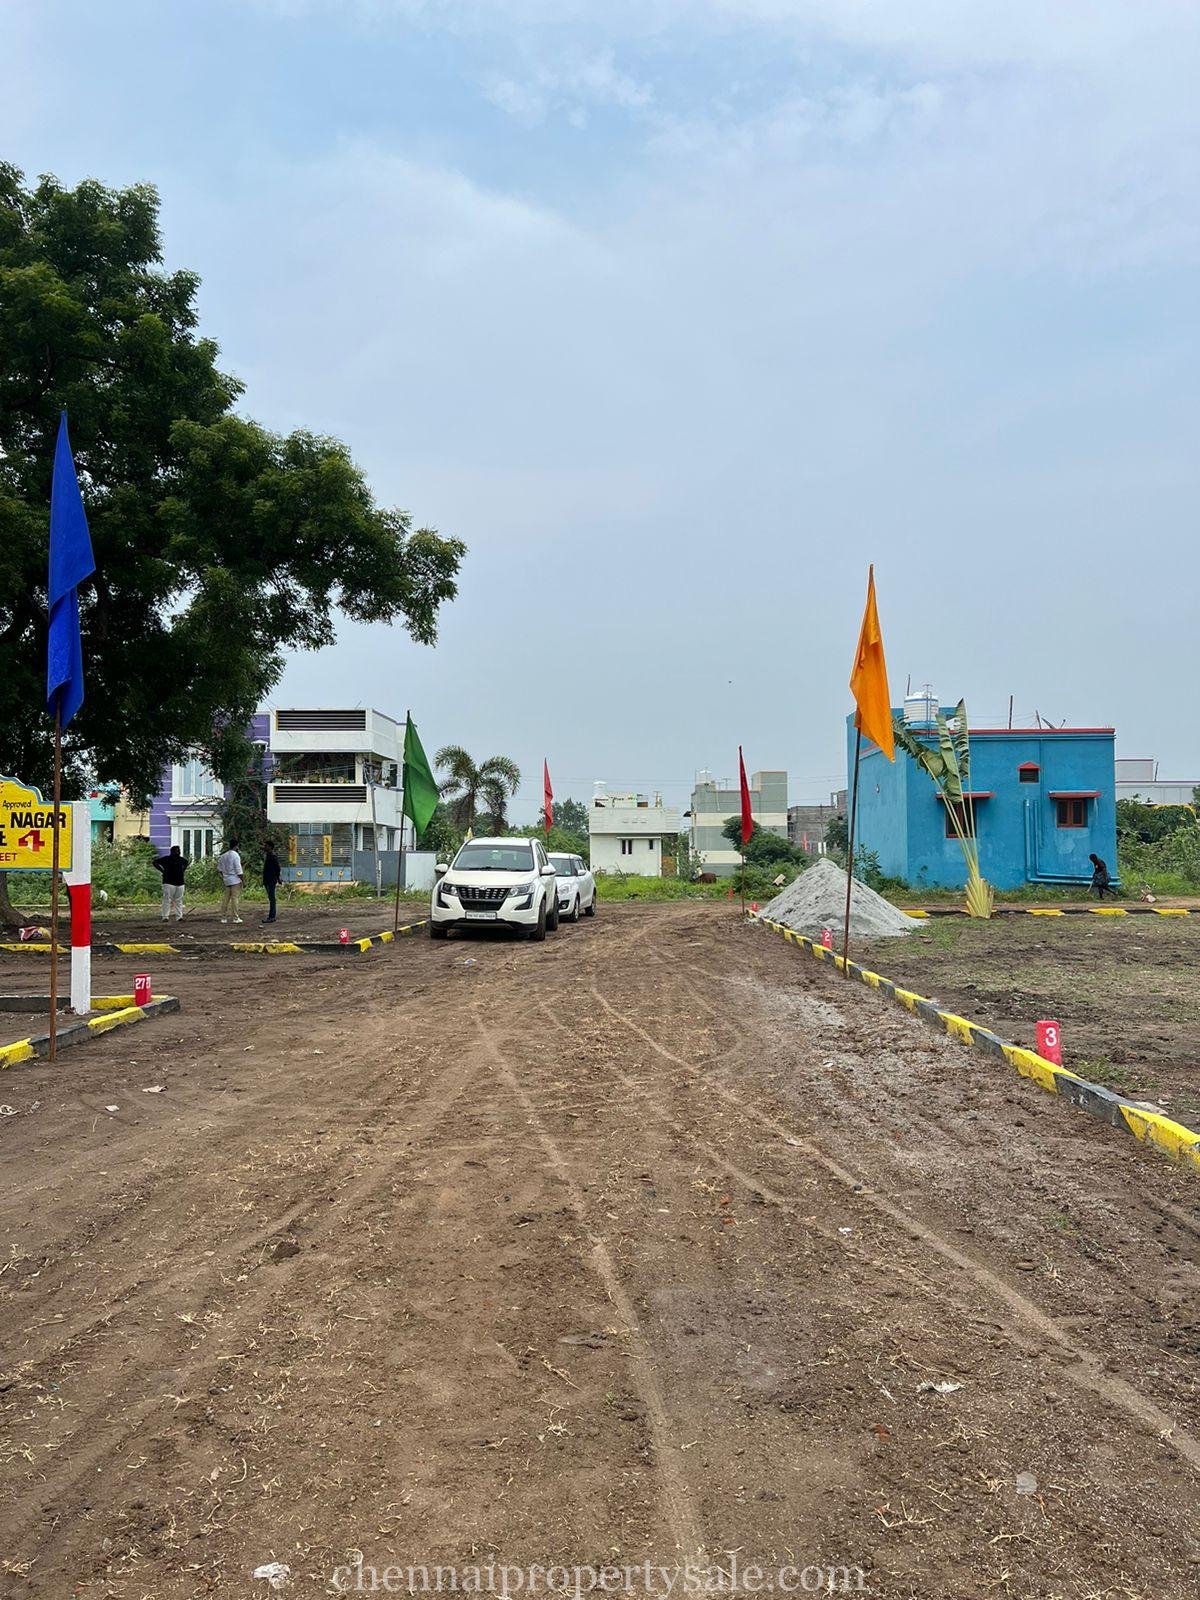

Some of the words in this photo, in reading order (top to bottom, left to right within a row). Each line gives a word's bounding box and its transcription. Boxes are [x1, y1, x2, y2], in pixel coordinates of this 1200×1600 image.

[2, 800, 32, 811] Approved
[10, 811, 67, 829] NAGAR
[18, 829, 45, 852] 4
[824, 932, 830, 942] 2
[135, 977, 146, 990] 27
[1045, 1027, 1057, 1047] 3
